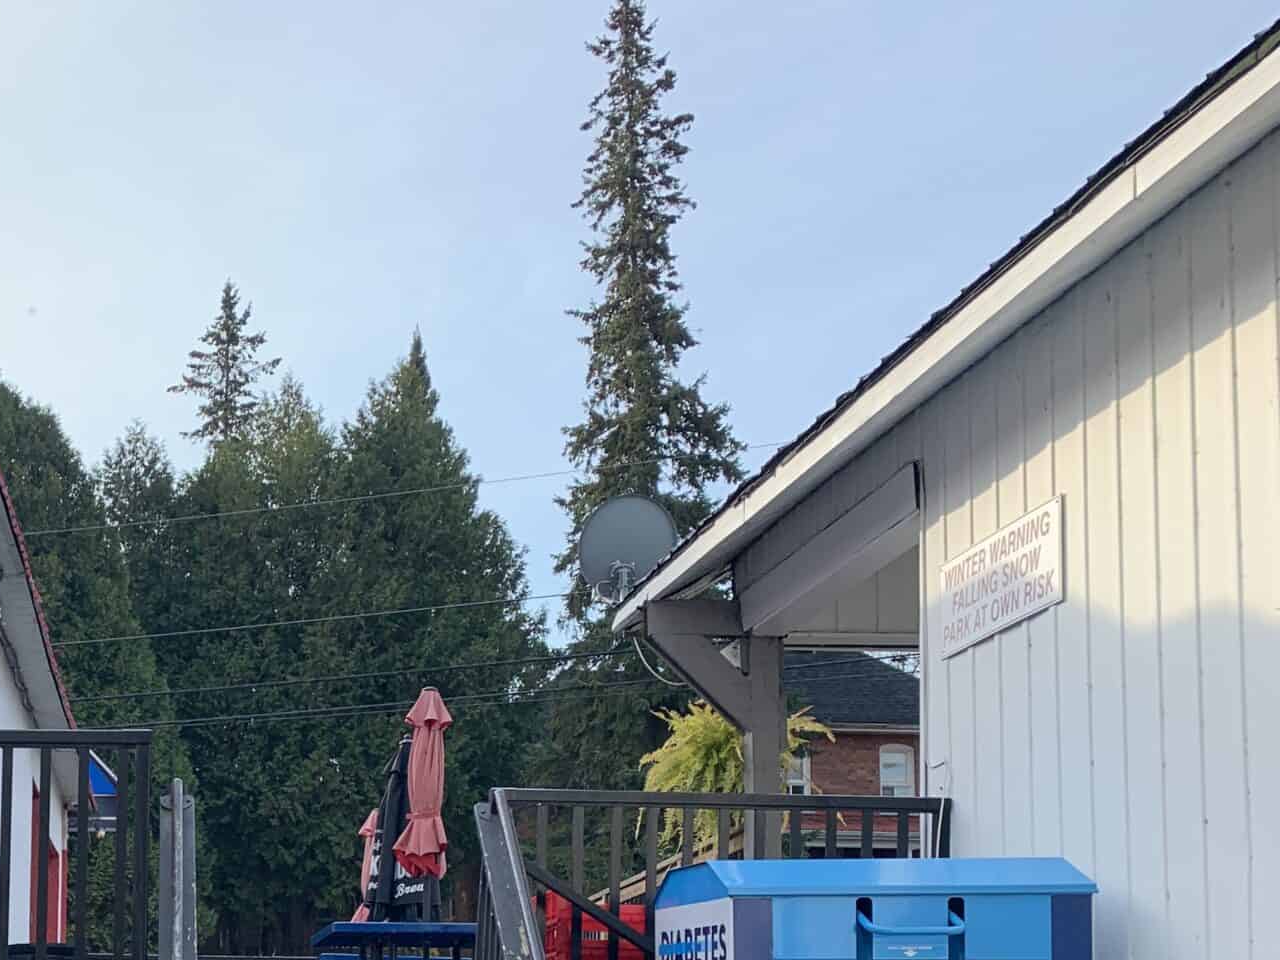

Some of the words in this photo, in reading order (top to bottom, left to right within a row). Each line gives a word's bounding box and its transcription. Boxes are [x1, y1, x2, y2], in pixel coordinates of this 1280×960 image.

[944, 549, 986, 591] WINTER
[989, 511, 1051, 563] WARNING
[952, 570, 998, 616] FALLING
[1001, 545, 1042, 587] SNOW
[943, 610, 970, 642] PARK
[973, 604, 987, 632] AT
[990, 590, 1020, 621] OWN
[1024, 569, 1055, 605] RISK
